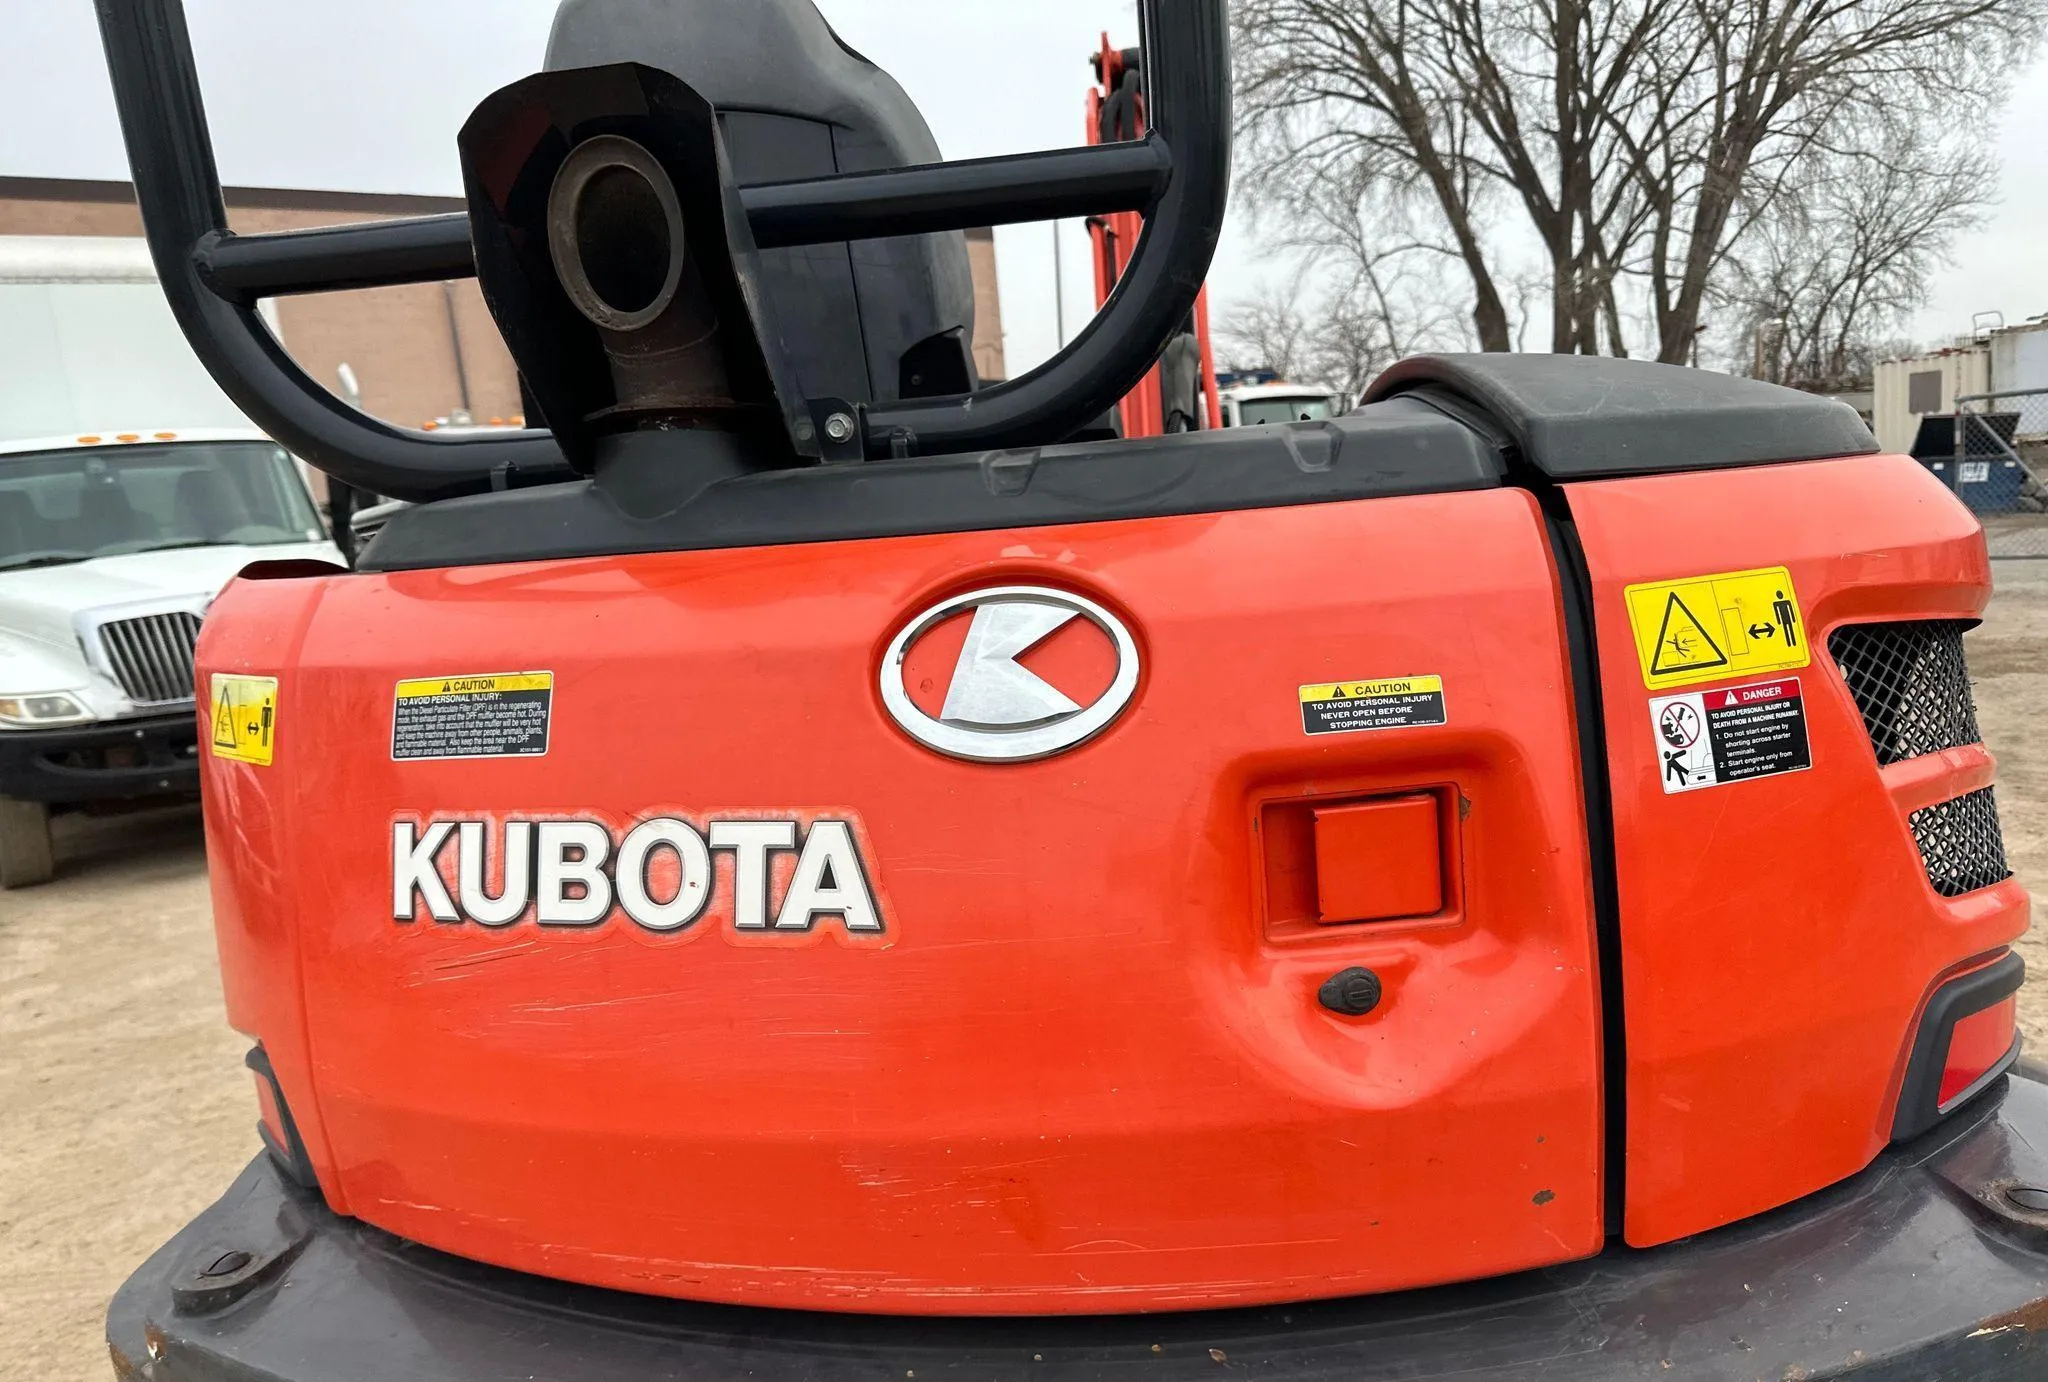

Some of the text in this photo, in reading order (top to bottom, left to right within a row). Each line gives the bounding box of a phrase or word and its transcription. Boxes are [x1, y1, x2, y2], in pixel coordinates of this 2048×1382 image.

[454, 680, 495, 691] CAUTION
[1355, 683, 1411, 695] CAUTION
[409, 696, 430, 705] AVOID
[431, 694, 470, 704] PERSONAL
[472, 692, 502, 701] INJURY:
[1742, 687, 1782, 700] DANGER
[1354, 698, 1400, 707] PERSONAL
[1403, 694, 1433, 703] INJURY
[1321, 706, 1413, 720] NEVER OPEN BEFORE
[1737, 707, 1764, 715] PERSONAL
[1765, 703, 1782, 711] INJURY
[1330, 720, 1373, 729] STOPPING
[1375, 717, 1406, 725] ENGINE
[1732, 718, 1747, 726] FROM
[1752, 714, 1775, 722] MACHINE
[1776, 710, 1799, 719] RUNAWAY.
[1761, 725, 1780, 733] engine
[1725, 739, 1750, 748] shorting
[1773, 732, 1791, 740] starter
[1727, 748, 1756, 757] terminals.
[1728, 759, 1743, 767] Start
[1745, 756, 1764, 764] engine
[1730, 766, 1760, 776] operator's
[393, 817, 881, 931] KUBOTA
